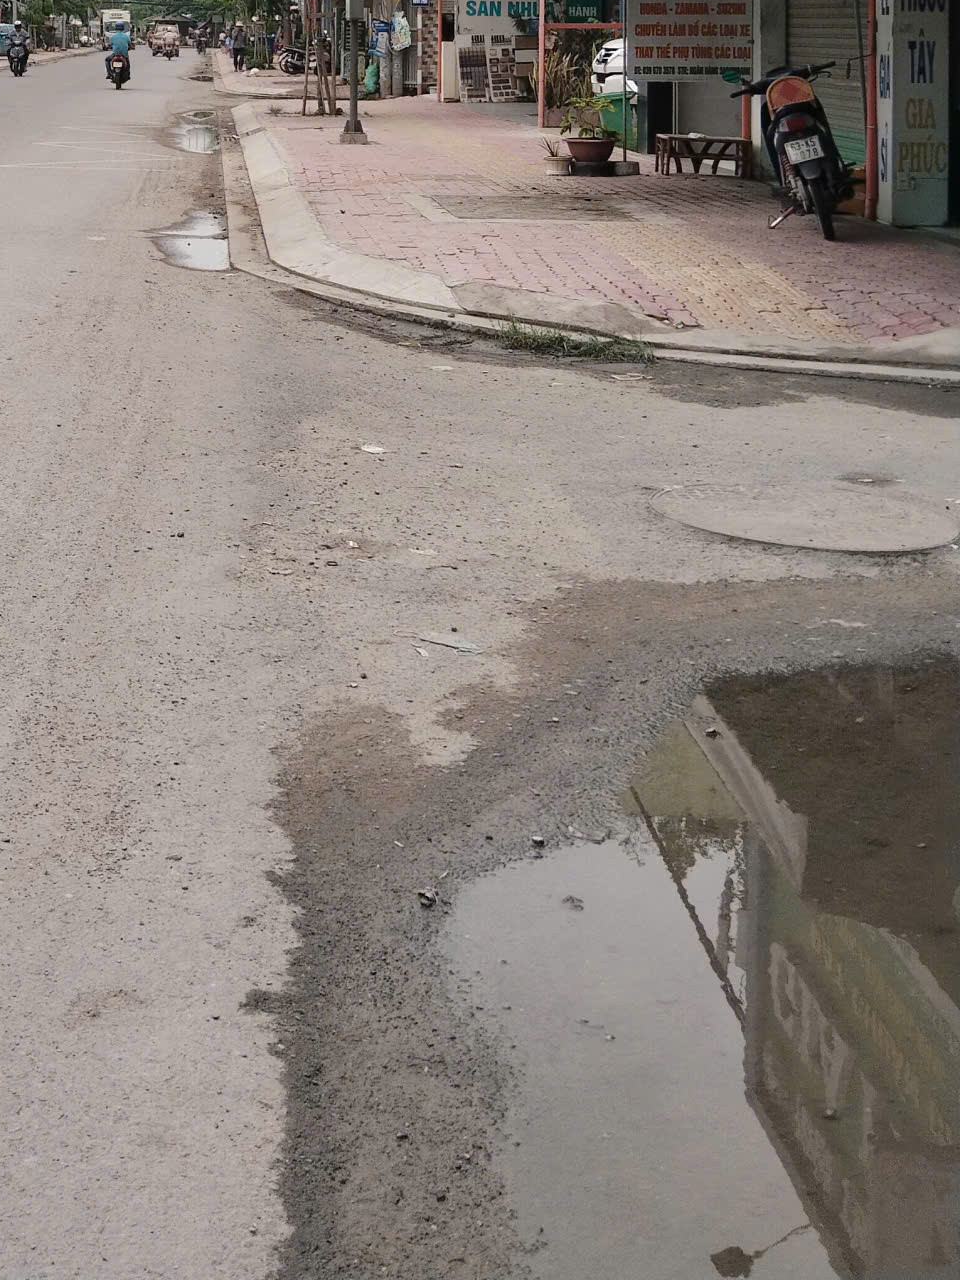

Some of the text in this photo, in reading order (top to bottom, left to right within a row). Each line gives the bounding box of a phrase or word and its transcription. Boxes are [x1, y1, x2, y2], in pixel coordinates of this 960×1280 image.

[907, 27, 936, 84] TÂY
[905, 98, 936, 130] GIA
[898, 134, 948, 173] PHÚC
